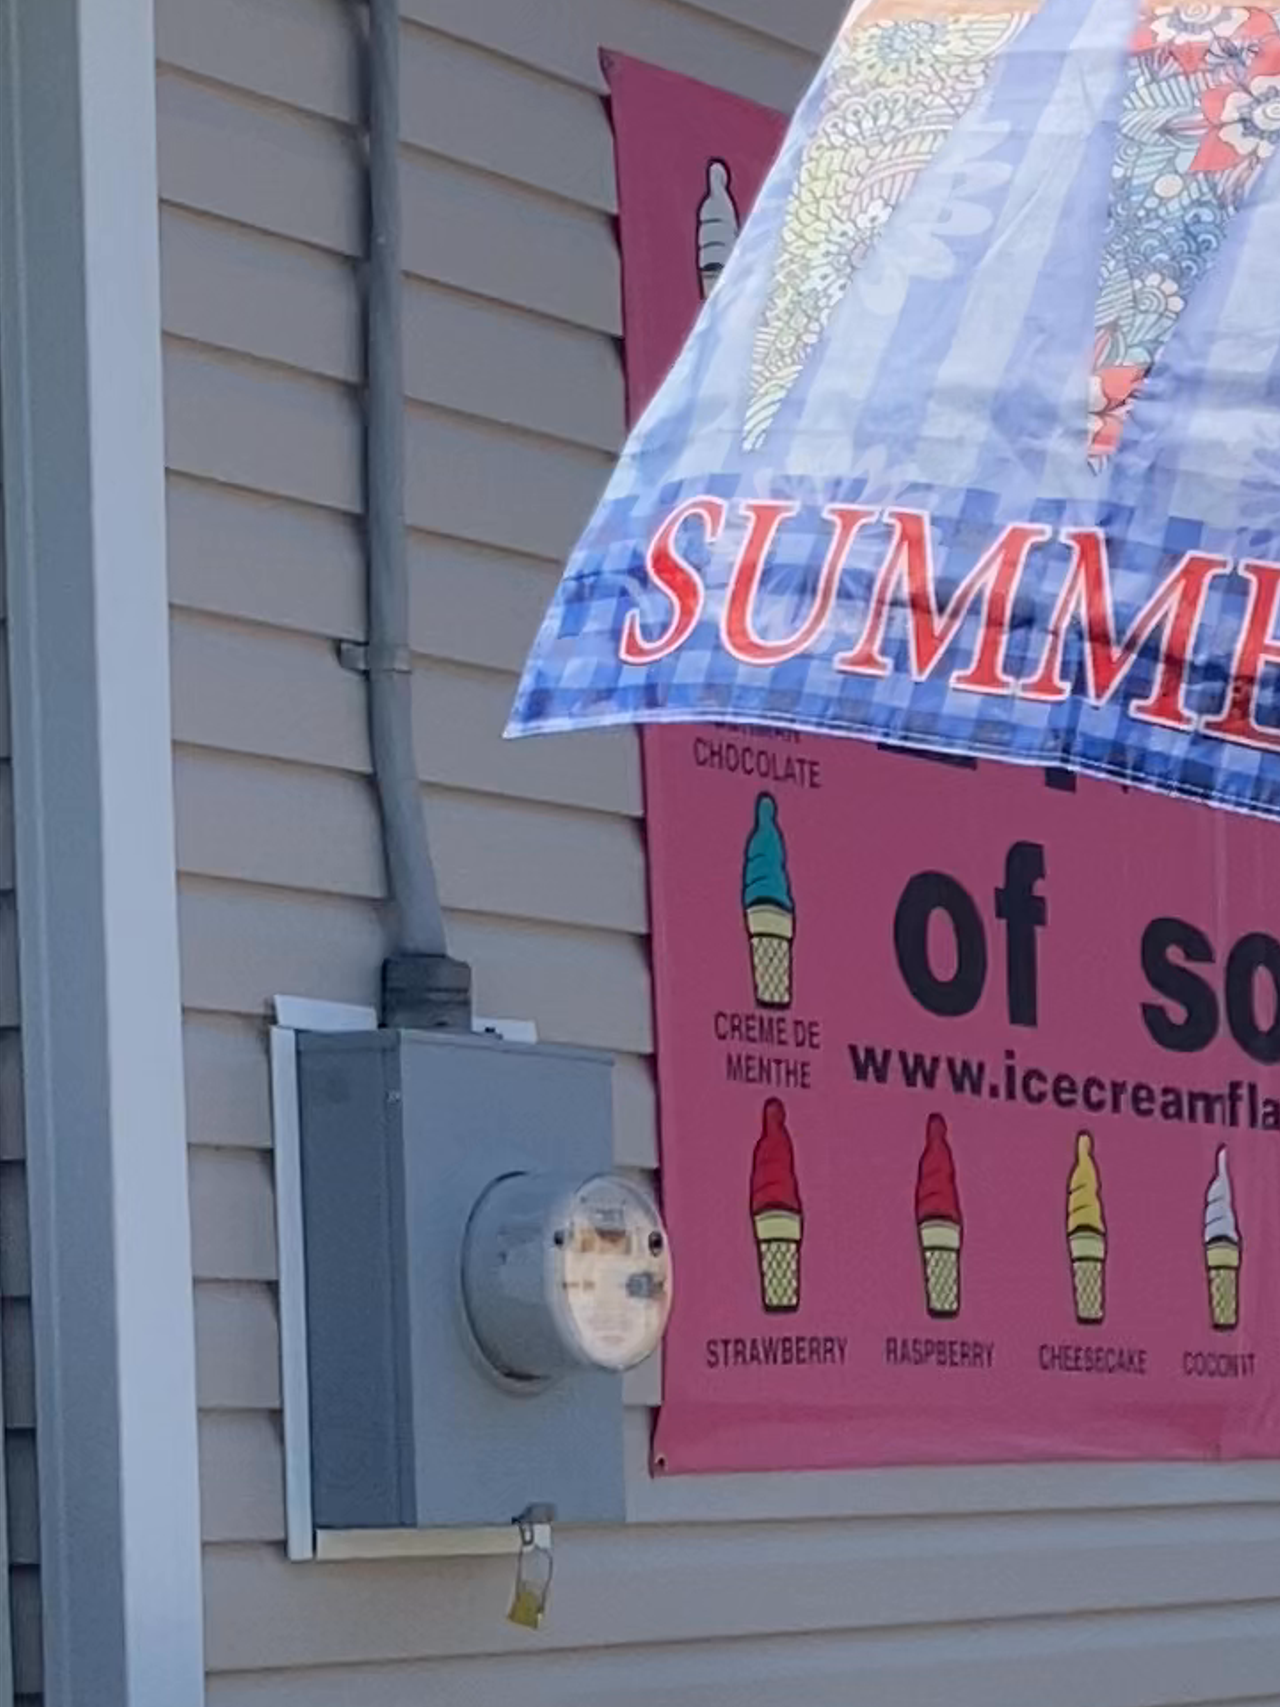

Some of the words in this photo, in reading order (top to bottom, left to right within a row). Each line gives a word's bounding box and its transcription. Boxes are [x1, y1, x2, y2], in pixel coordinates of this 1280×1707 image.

[692, 736, 823, 789] CHOCOLATE
[893, 839, 1047, 1028] of
[713, 1010, 788, 1045] CREME
[793, 1019, 821, 1050] DE
[725, 1052, 812, 1089] MENTHE
[706, 1336, 848, 1369] STRAWBERRY
[886, 1336, 995, 1369] RASPBERRY
[1038, 1343, 1147, 1375] CHEESECAKE
